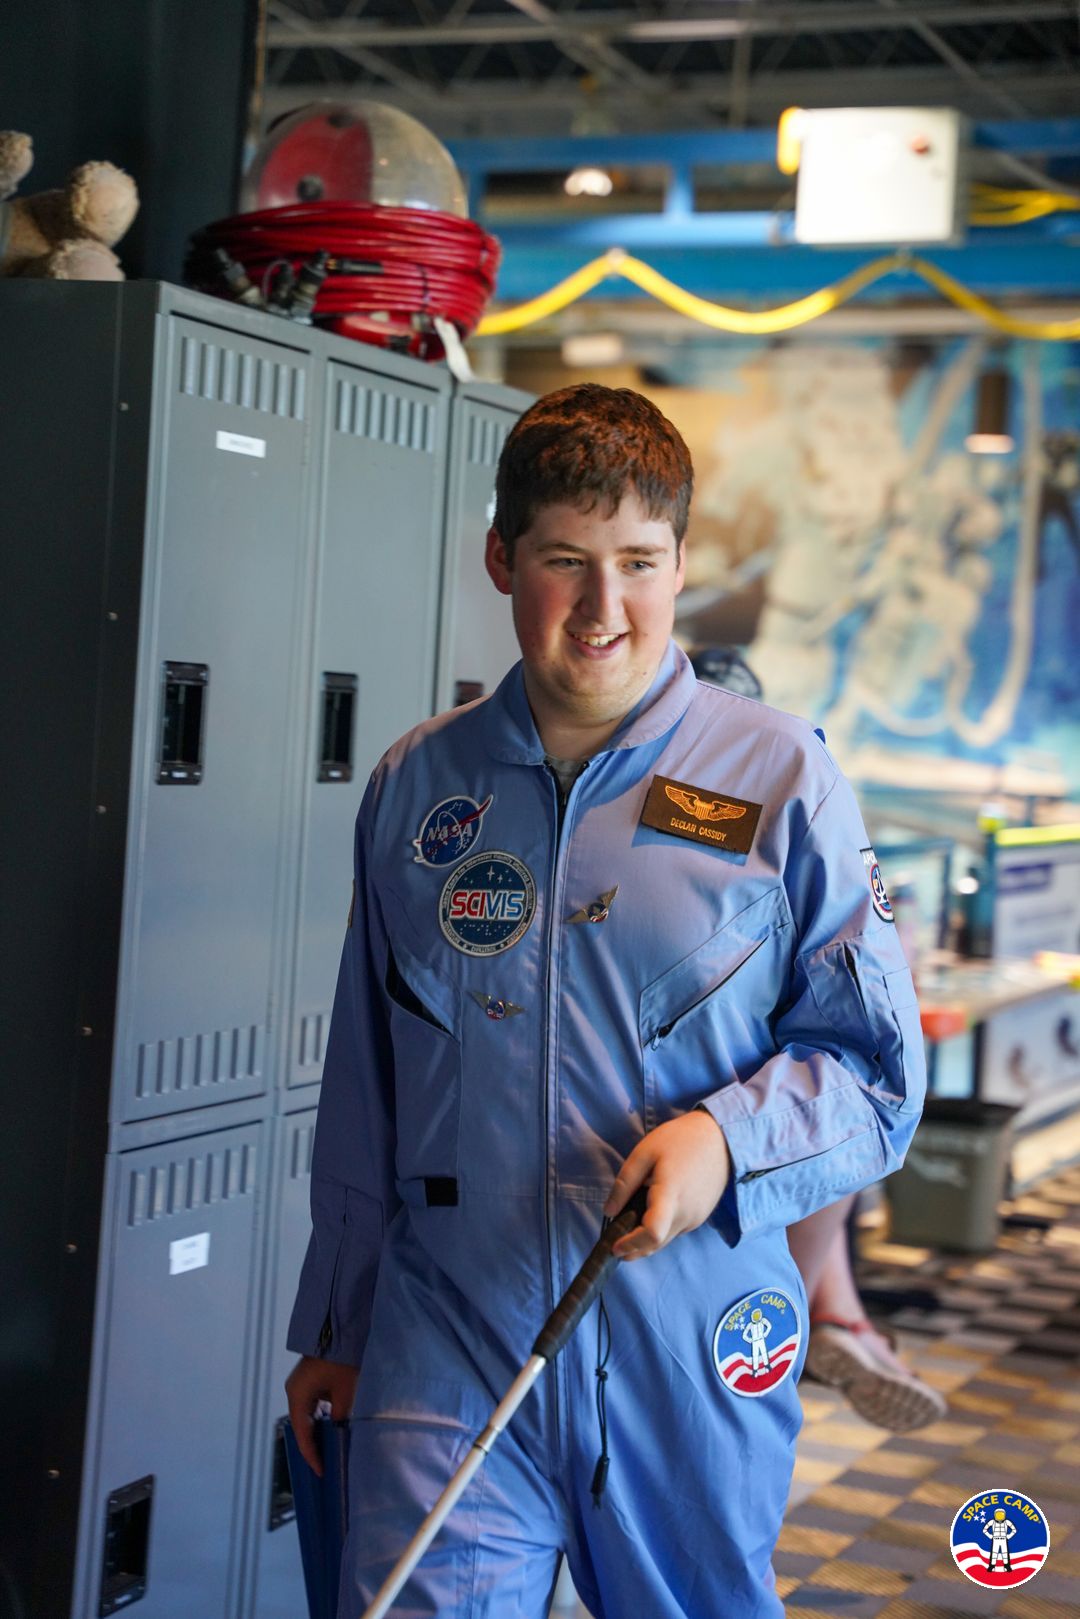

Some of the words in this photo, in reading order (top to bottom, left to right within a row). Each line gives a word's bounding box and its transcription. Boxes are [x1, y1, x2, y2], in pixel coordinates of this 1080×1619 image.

[426, 823, 473, 842] NASA
[670, 817, 696, 833] DECLAN
[698, 826, 727, 842] CASSIDY
[448, 890, 526, 920] SCIVIS
[724, 1300, 752, 1332] SPACE
[760, 1294, 787, 1311] CAMP
